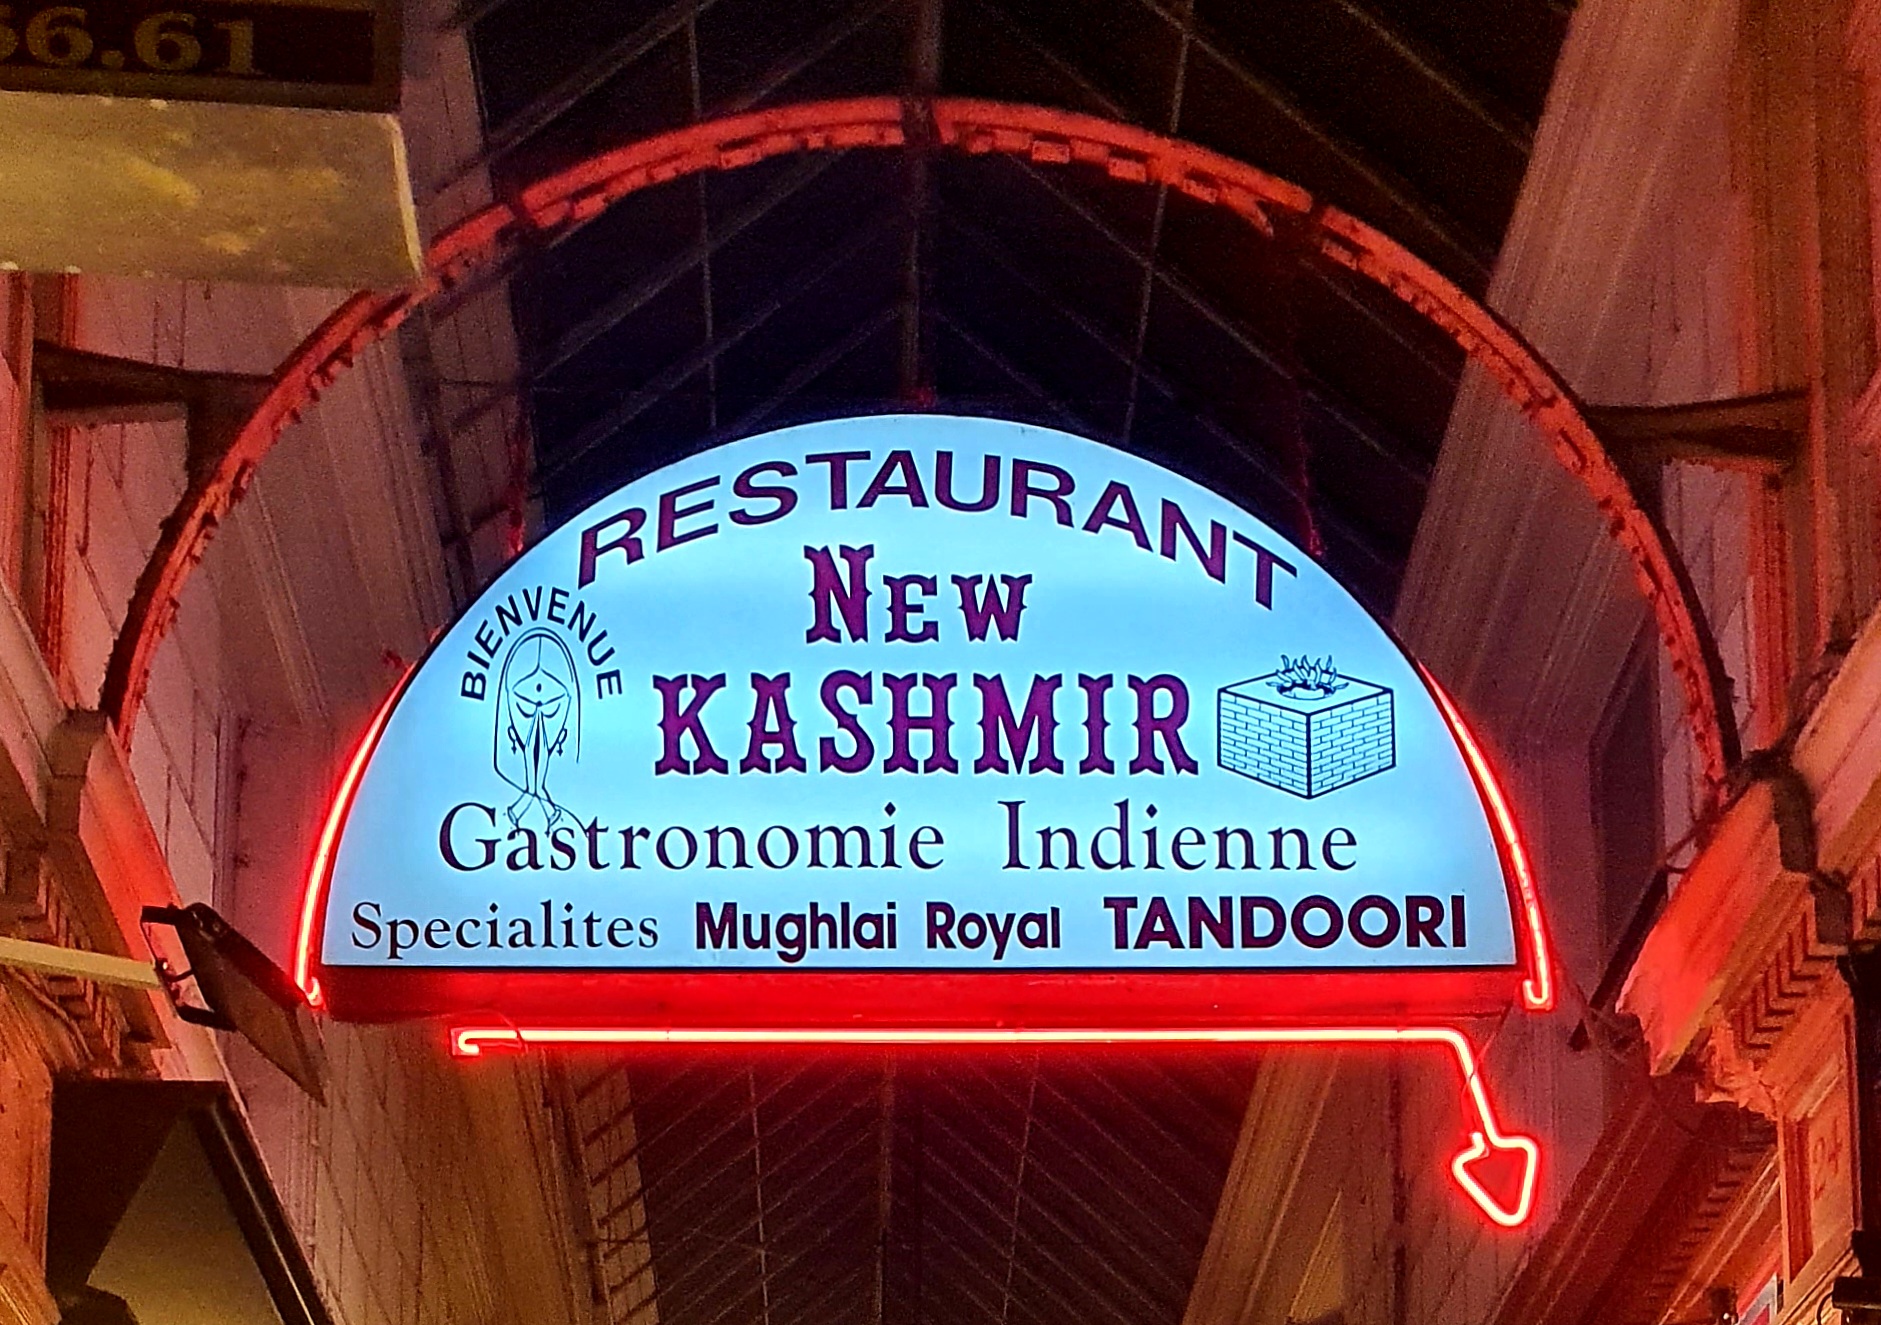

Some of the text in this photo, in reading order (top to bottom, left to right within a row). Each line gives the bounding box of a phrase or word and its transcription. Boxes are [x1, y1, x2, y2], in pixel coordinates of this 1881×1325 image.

[578, 449, 1297, 611] RESTAURANT
[461, 586, 623, 701] BIENVENUE
[652, 670, 1198, 776] KASHMIR
[438, 800, 1357, 872] Gastronomie Indienne
[351, 895, 1467, 962] Specialites Mughlai Royal TANDOORI
